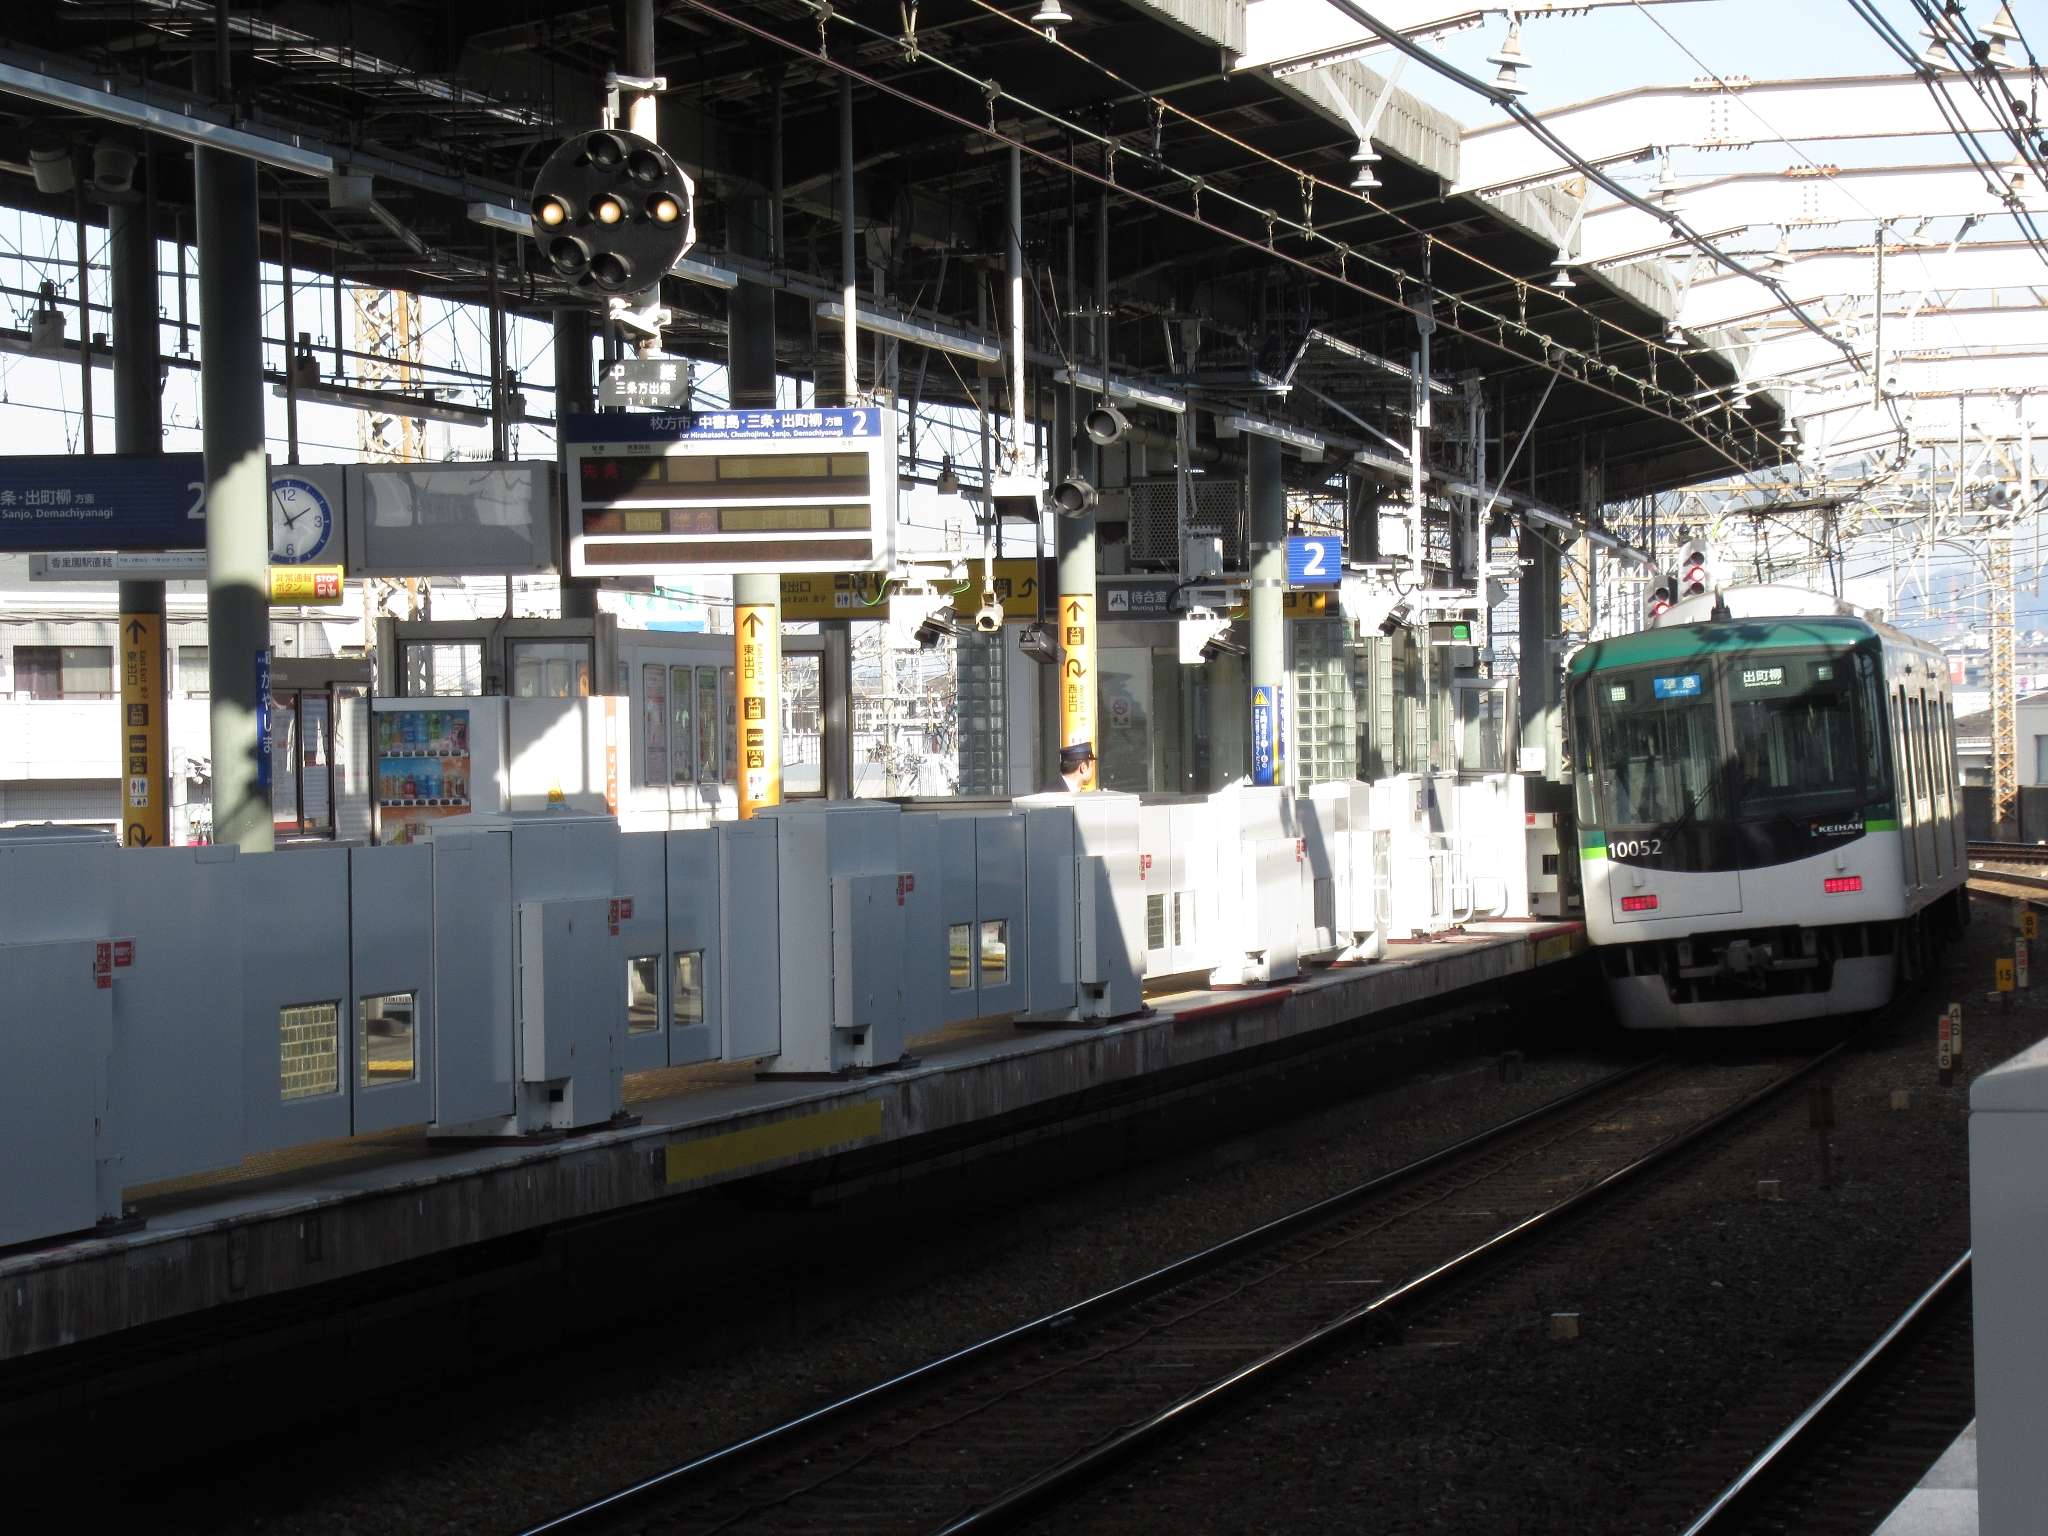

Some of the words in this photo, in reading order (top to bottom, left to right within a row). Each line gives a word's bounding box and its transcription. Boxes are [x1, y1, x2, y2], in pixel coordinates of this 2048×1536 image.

[825, 416, 843, 427] 方面
[852, 410, 868, 436] 2
[772, 430, 792, 438] Sanjo,
[75, 493, 95, 504] 方面
[187, 482, 206, 519] 2
[281, 488, 296, 501] 12
[2, 508, 33, 521] Sanjo,
[36, 507, 113, 520] Demachiyanagi
[314, 515, 323, 528] 3
[286, 543, 295, 556] 6
[1303, 542, 1326, 576] 2
[315, 575, 338, 583] STOP
[275, 583, 302, 593] ボタン
[1130, 590, 1168, 605] 待合室
[743, 644, 755, 679] 東出口
[1743, 668, 1782, 683] 出町柳
[1068, 684, 1078, 713] 西出口
[261, 671, 273, 754] かやしま
[1818, 822, 1864, 833] KEIHAN
[1607, 839, 1664, 859] 10052
[1999, 968, 2012, 982] 15
